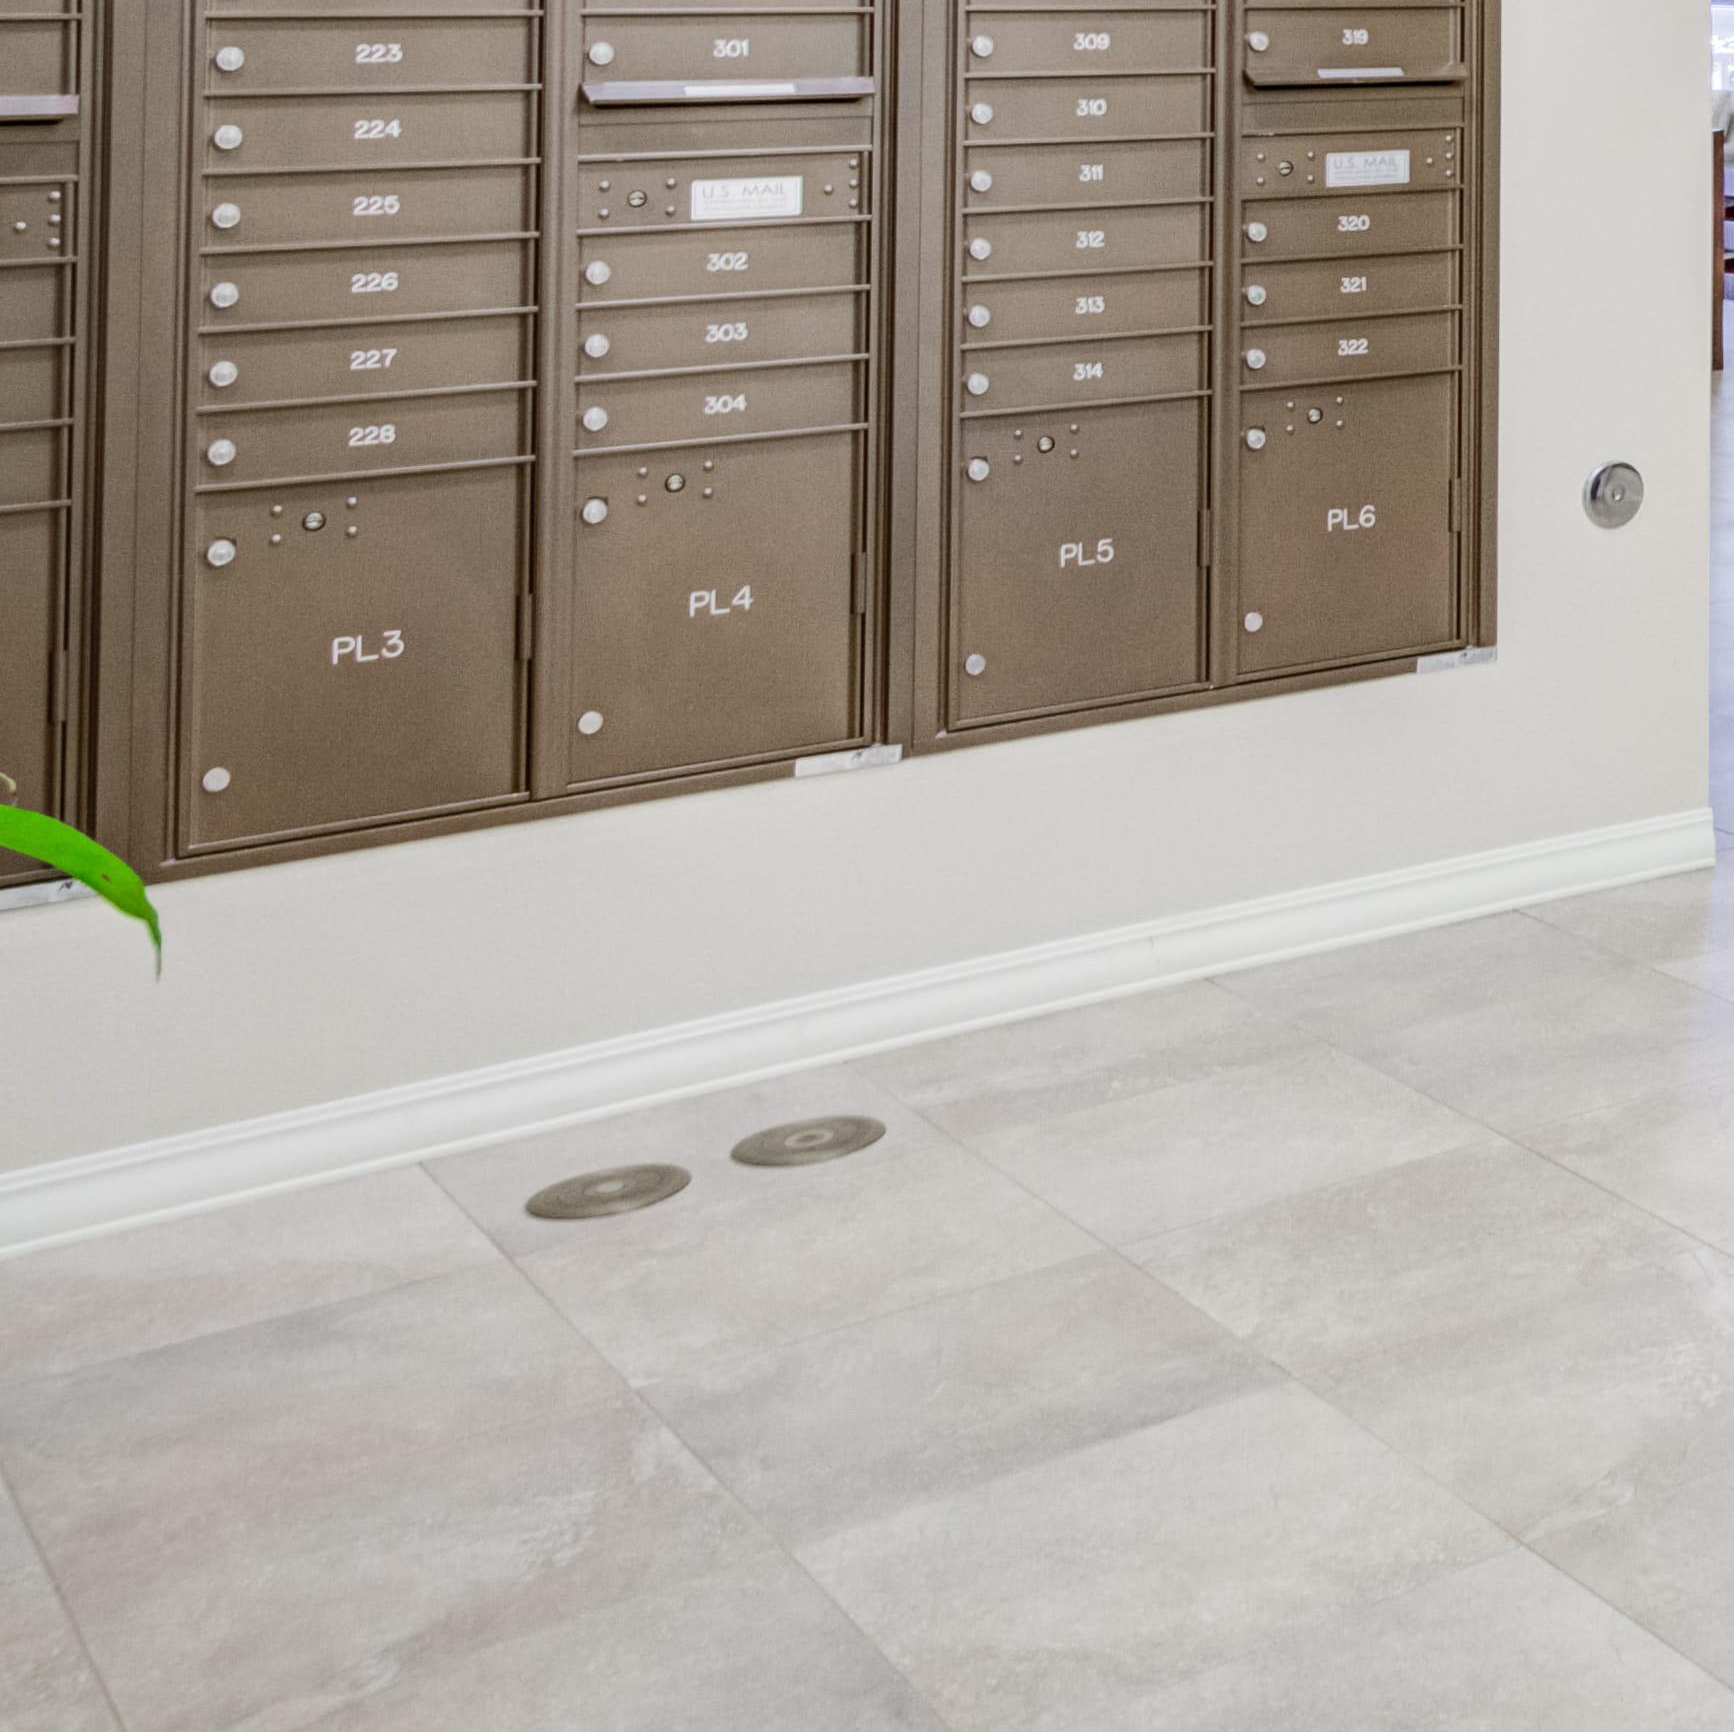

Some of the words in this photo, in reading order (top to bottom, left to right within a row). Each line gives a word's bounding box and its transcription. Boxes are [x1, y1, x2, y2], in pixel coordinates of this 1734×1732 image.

[1073, 32, 1111, 51] 309
[1341, 28, 1369, 45] 319
[355, 43, 403, 64] 223
[712, 39, 749, 58] 301
[1076, 98, 1107, 117] 310
[353, 119, 402, 140] 224
[1079, 164, 1104, 182] 311
[742, 183, 786, 197] MAIL
[352, 194, 401, 216] 225
[1337, 214, 1371, 232] 320
[1075, 230, 1105, 249] 312
[706, 251, 749, 272] 302
[351, 271, 399, 294] 226
[1340, 276, 1367, 294] 321
[1074, 296, 1106, 315] 313
[705, 322, 748, 343] 303
[1337, 338, 1369, 356] 322
[349, 348, 398, 371] 227
[1073, 362, 1104, 381] 314
[704, 393, 747, 415] 304
[348, 424, 396, 447] 228
[1327, 504, 1376, 532] PL6
[1059, 538, 1115, 568] PL5
[689, 585, 754, 618] PL4
[331, 629, 405, 665] PL3
